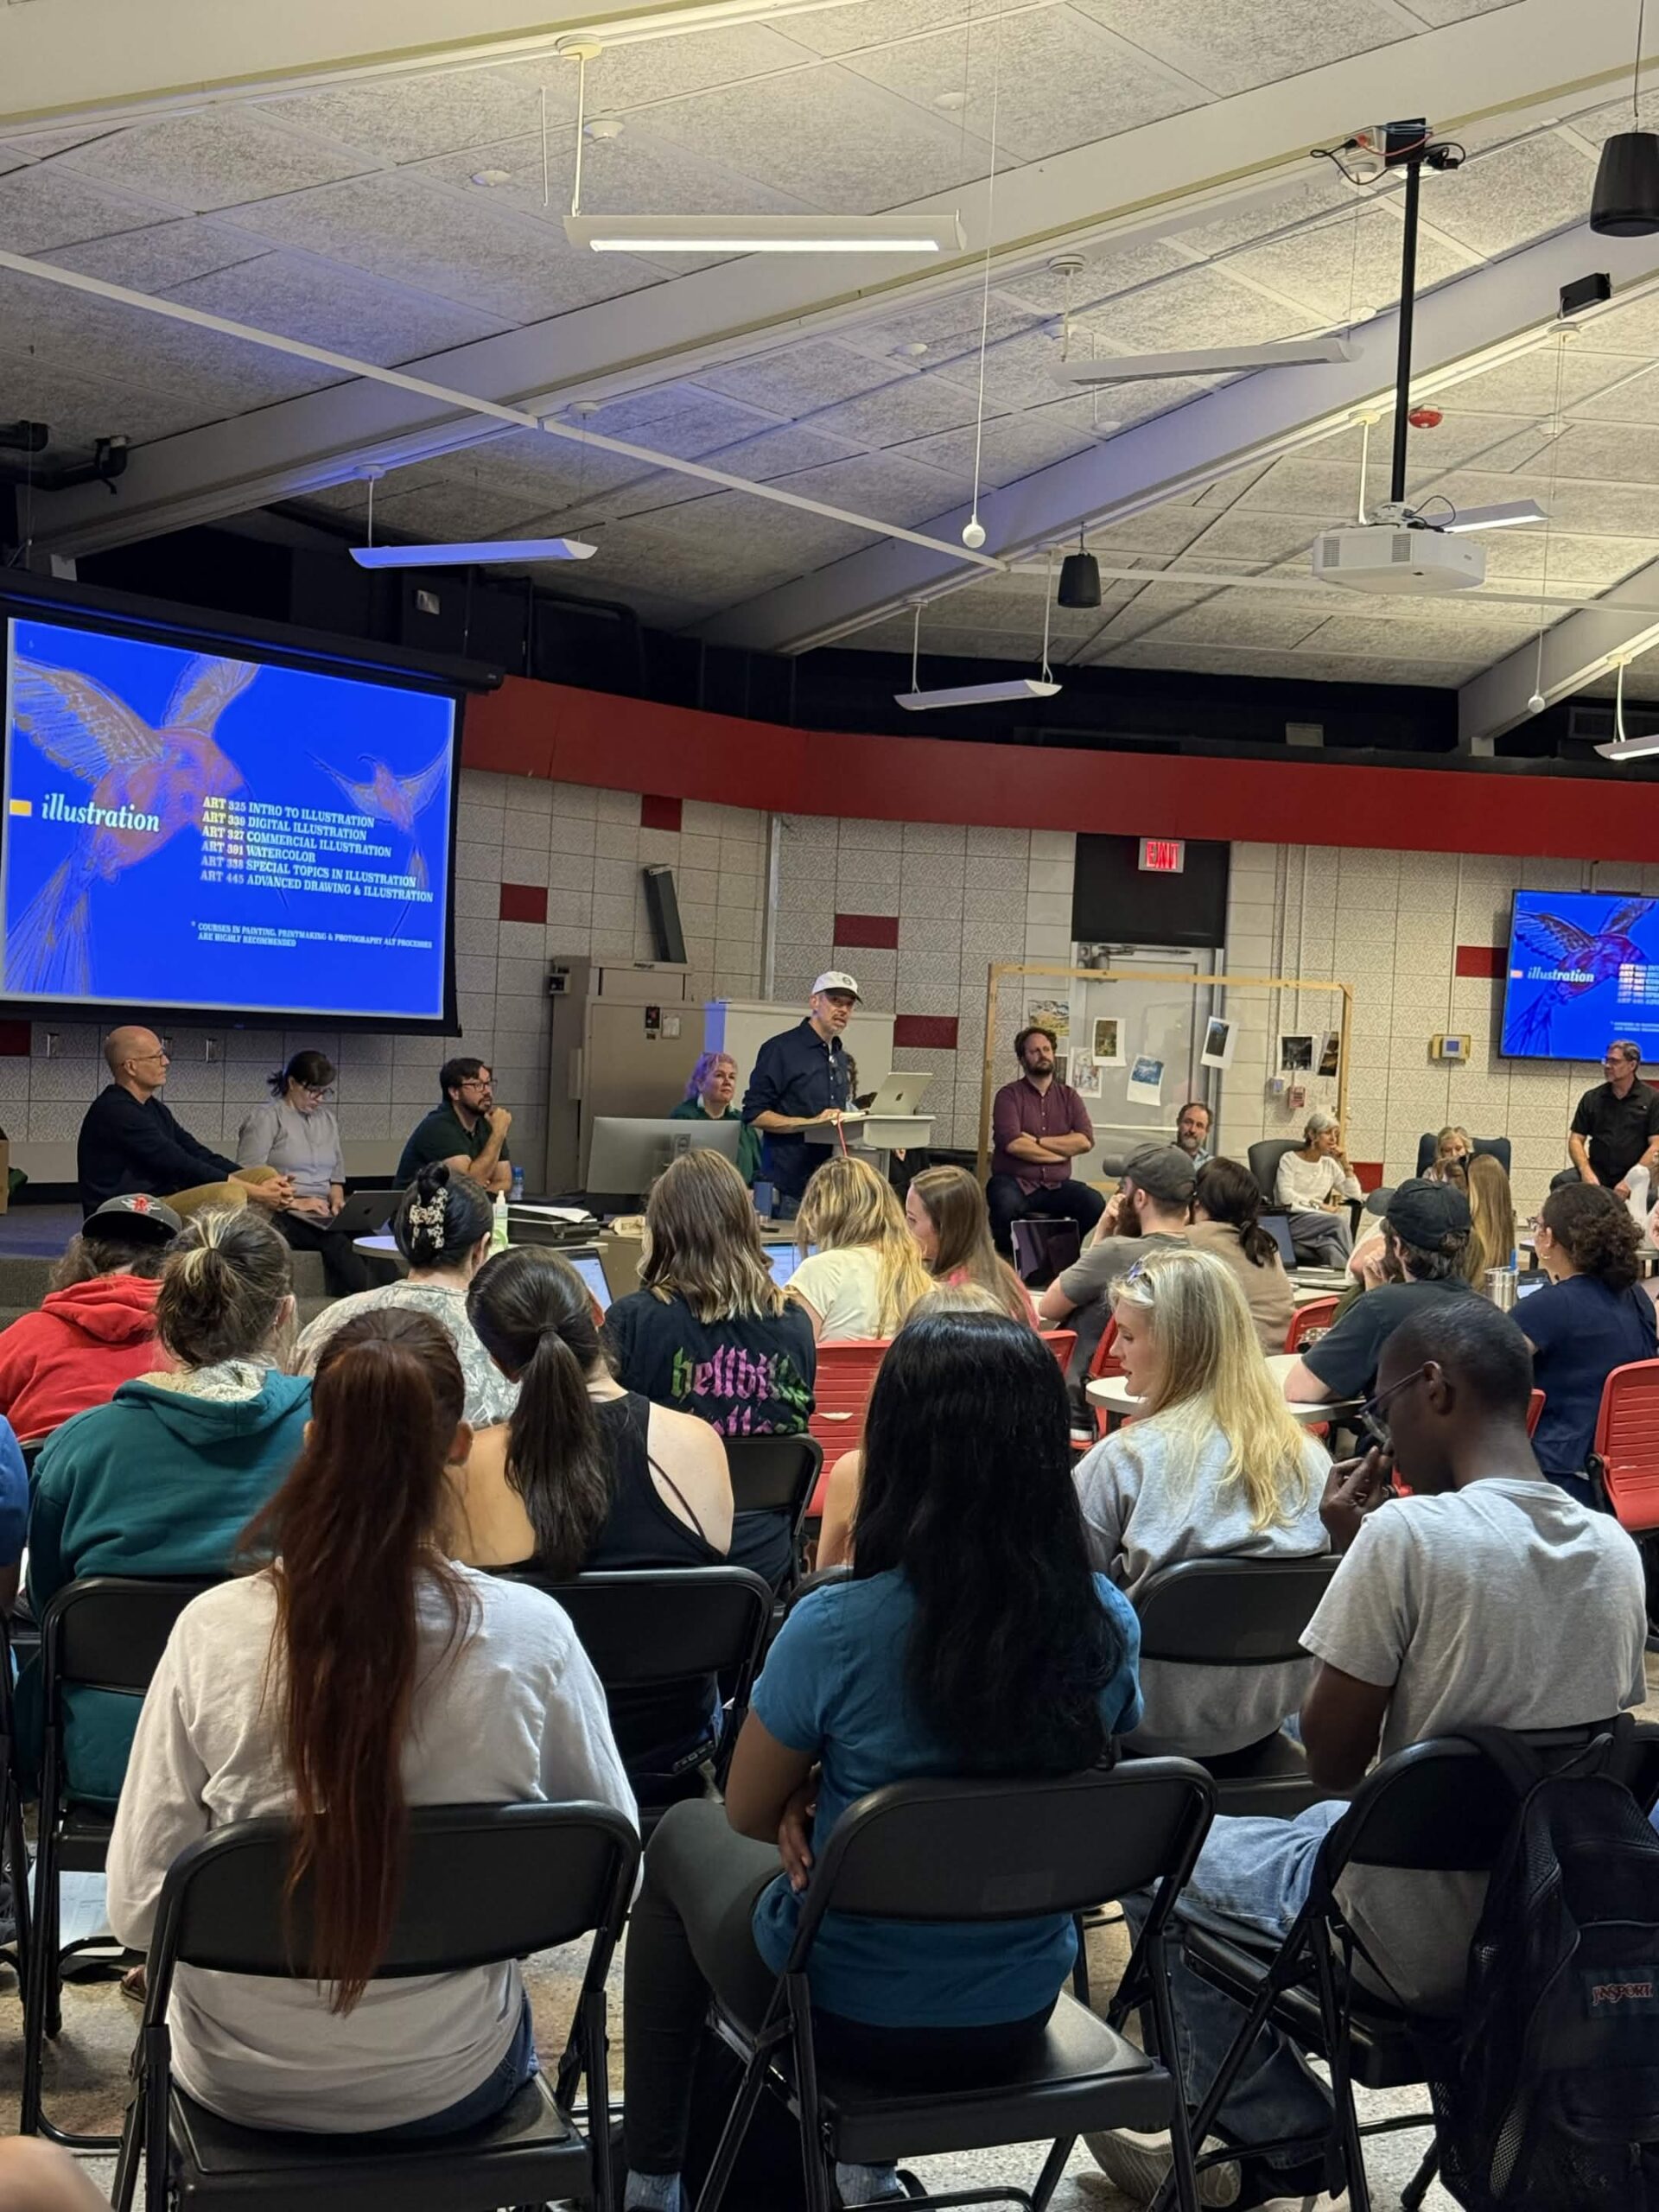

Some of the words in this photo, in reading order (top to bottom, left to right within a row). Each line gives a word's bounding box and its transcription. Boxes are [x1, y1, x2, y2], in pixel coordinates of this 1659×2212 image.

[41, 792, 160, 832] illustration
[201, 811, 226, 823] ART
[248, 817, 291, 832] DIGITAL
[293, 823, 367, 841] ILLUSTRATION
[202, 797, 226, 810] ART
[228, 801, 246, 812] 325
[248, 802, 283, 817] INTRO
[284, 807, 299, 818] TO
[301, 809, 375, 828] ILLUSTRATION
[200, 841, 225, 854] ART
[246, 845, 316, 863] WATERCOLOR
[201, 826, 226, 838] ART
[227, 830, 245, 841] 327
[246, 831, 317, 849] COMMERCIAL
[319, 840, 392, 857] ILLUSTRATION
[200, 855, 225, 868] ART
[246, 860, 291, 874] SPECIAL
[293, 865, 329, 878] TOPICS
[332, 868, 344, 880] IN
[345, 870, 416, 887] ILLUSTRATION
[200, 870, 224, 882] ART
[226, 874, 245, 885] 445
[246, 874, 302, 890] ADVANCED
[304, 880, 352, 895] DRAWING
[353, 885, 361, 896] &
[364, 886, 434, 903] ILLUSTRATION
[198, 923, 232, 933] COURSES
[232, 925, 241, 934] IN
[277, 930, 327, 941] PRINTMAKING
[334, 934, 383, 945] PHOTOGRAPHY
[198, 932, 213, 941] ARE
[214, 934, 242, 944] HIGHLY
[242, 937, 296, 948] RECOMMENDED
[1527, 966, 1594, 982] illustration
